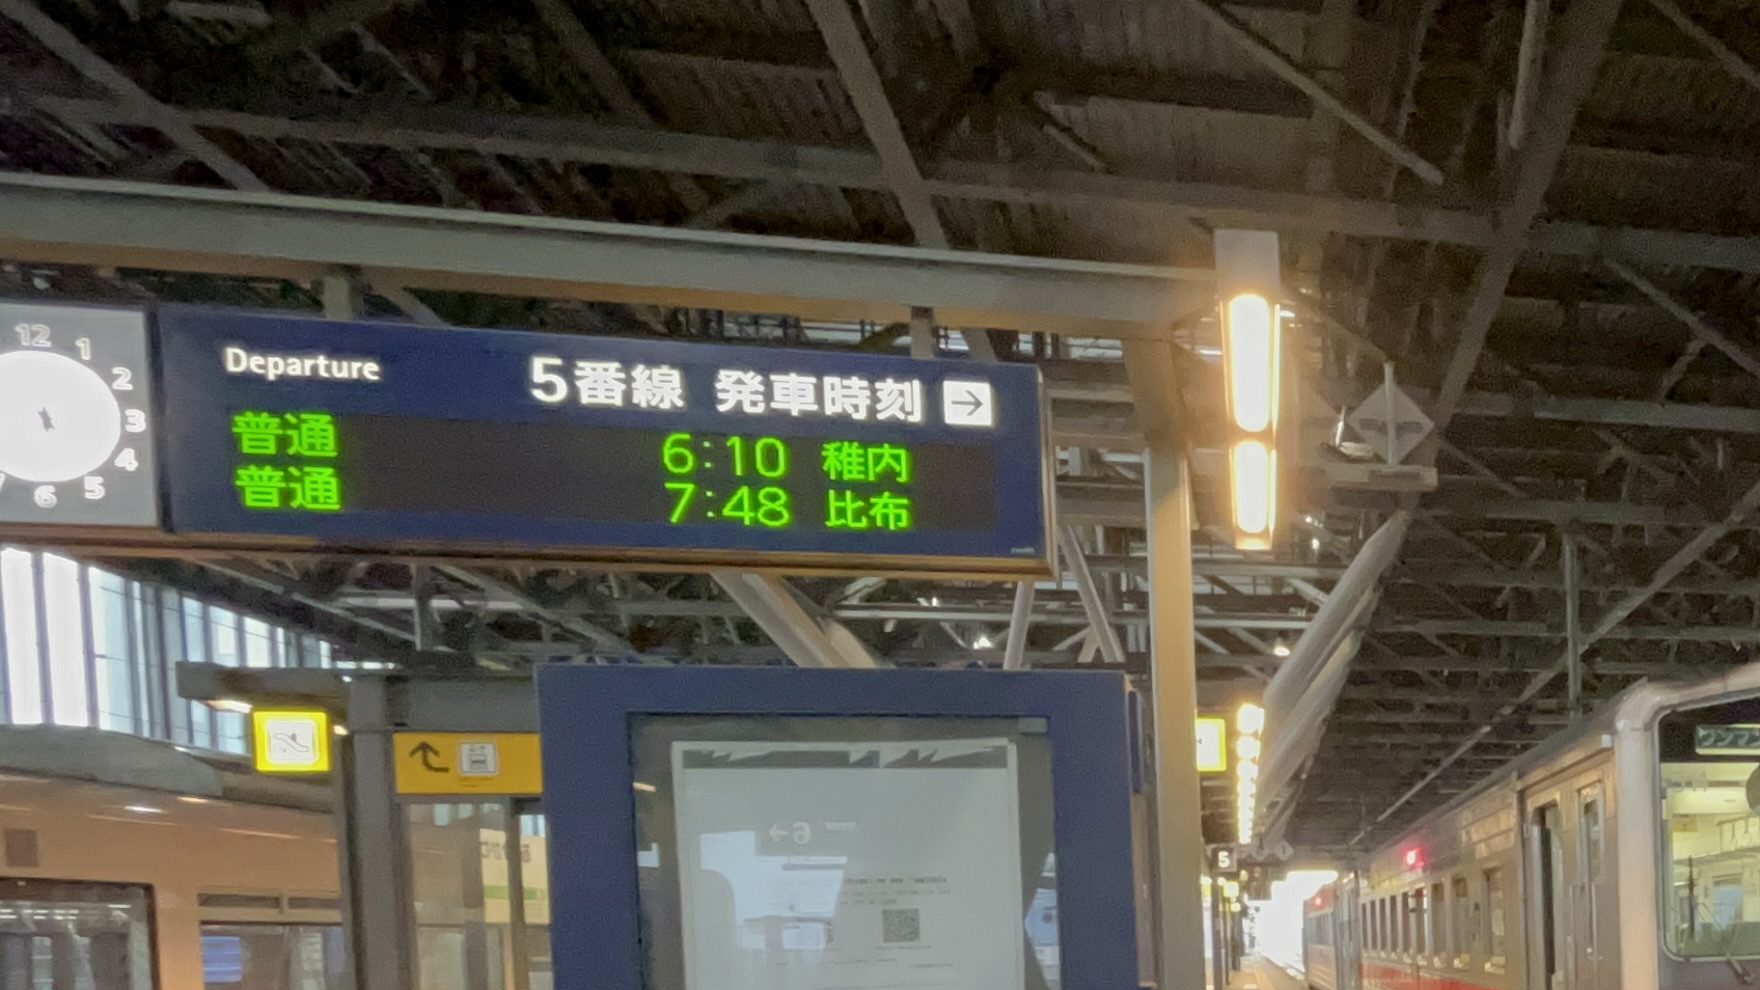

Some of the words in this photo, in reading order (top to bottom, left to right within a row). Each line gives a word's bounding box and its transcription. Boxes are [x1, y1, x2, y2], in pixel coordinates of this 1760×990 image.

[16, 324, 51, 347] 12
[77, 338, 91, 360] 1
[224, 347, 382, 381] Departure
[112, 367, 132, 390] 2
[530, 356, 686, 408] 5番線
[715, 368, 923, 423] 発車時刻
[125, 410, 145, 432] 3
[232, 411, 339, 458] 普通
[662, 433, 786, 478] 6:10
[821, 441, 909, 482] 稚内
[115, 448, 138, 471] 4
[35, 485, 57, 508] 6
[84, 476, 105, 499] 5
[235, 465, 341, 509] 普通
[664, 482, 789, 527] 7:48
[825, 491, 910, 530] 比布
[1217, 850, 1231, 869] 5
